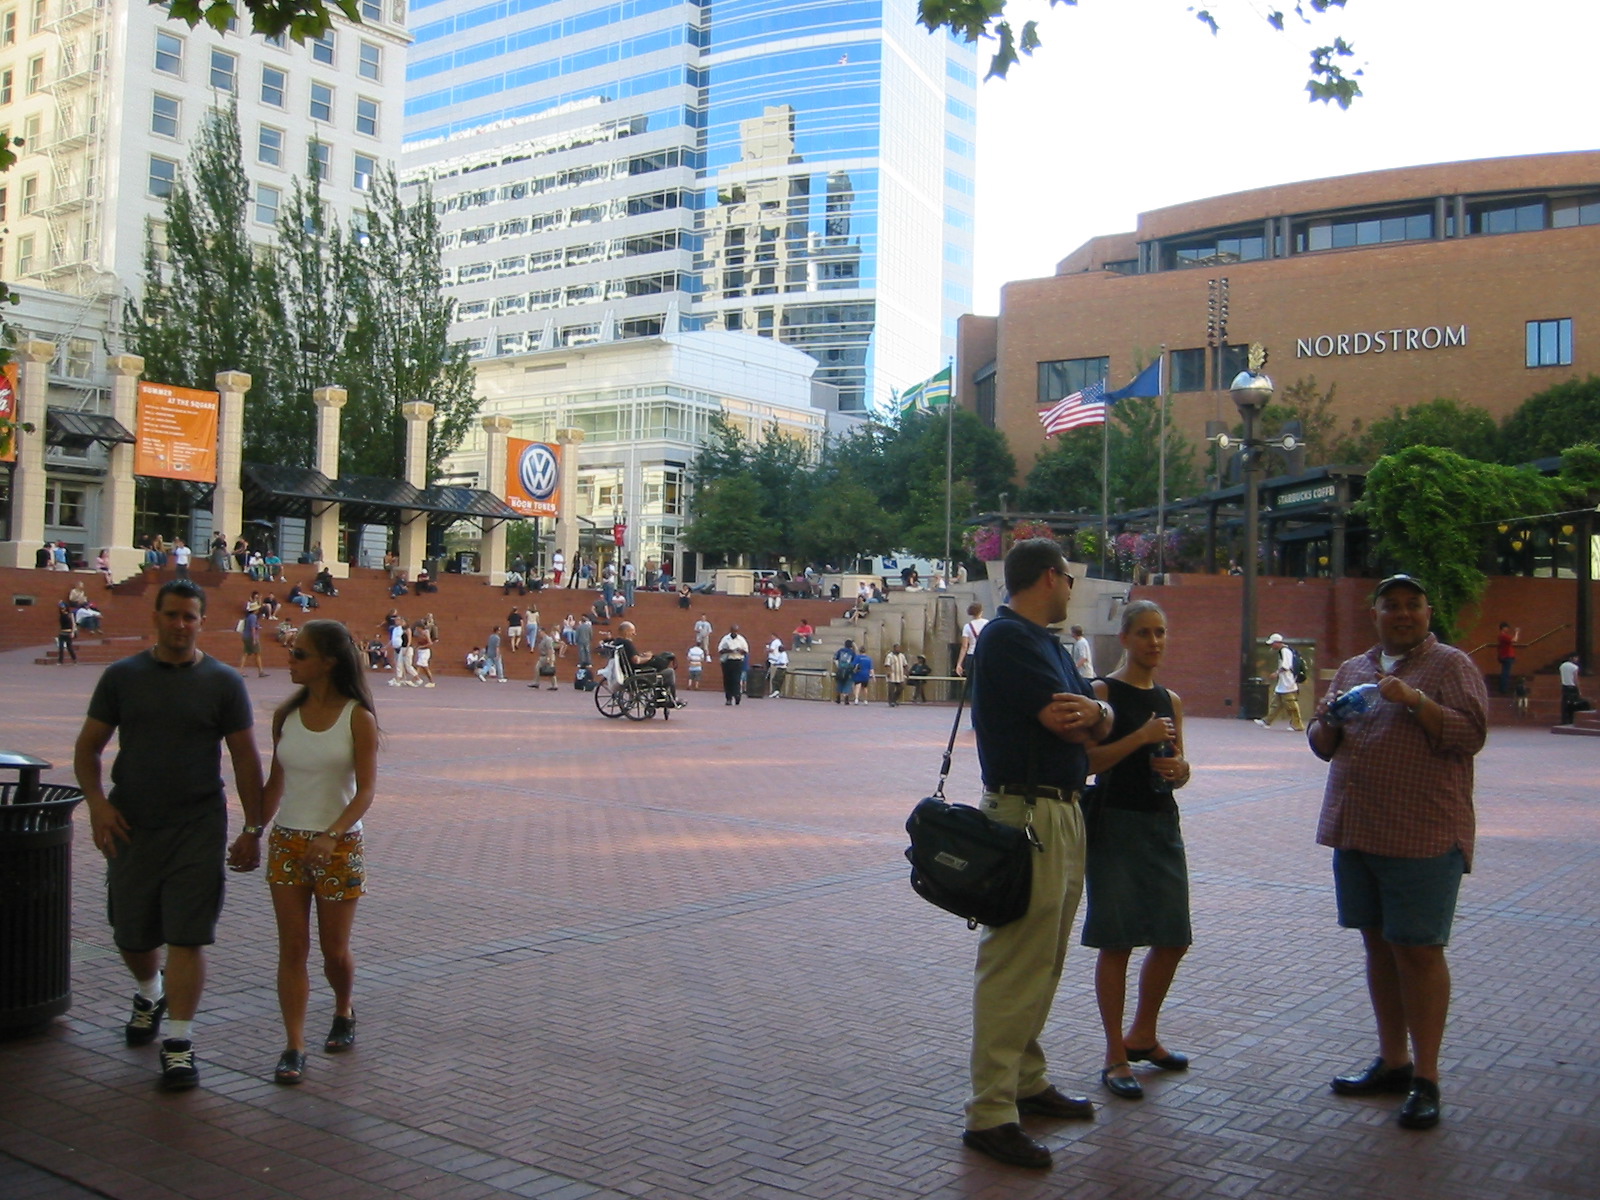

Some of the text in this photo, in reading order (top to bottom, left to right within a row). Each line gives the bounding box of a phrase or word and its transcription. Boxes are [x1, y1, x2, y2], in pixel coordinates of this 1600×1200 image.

[1296, 324, 1467, 359] NORDSTROM
[142, 386, 173, 397] SUMMER
[167, 397, 176, 405] AT
[177, 398, 190, 407] THE
[190, 400, 216, 411] SQUARE
